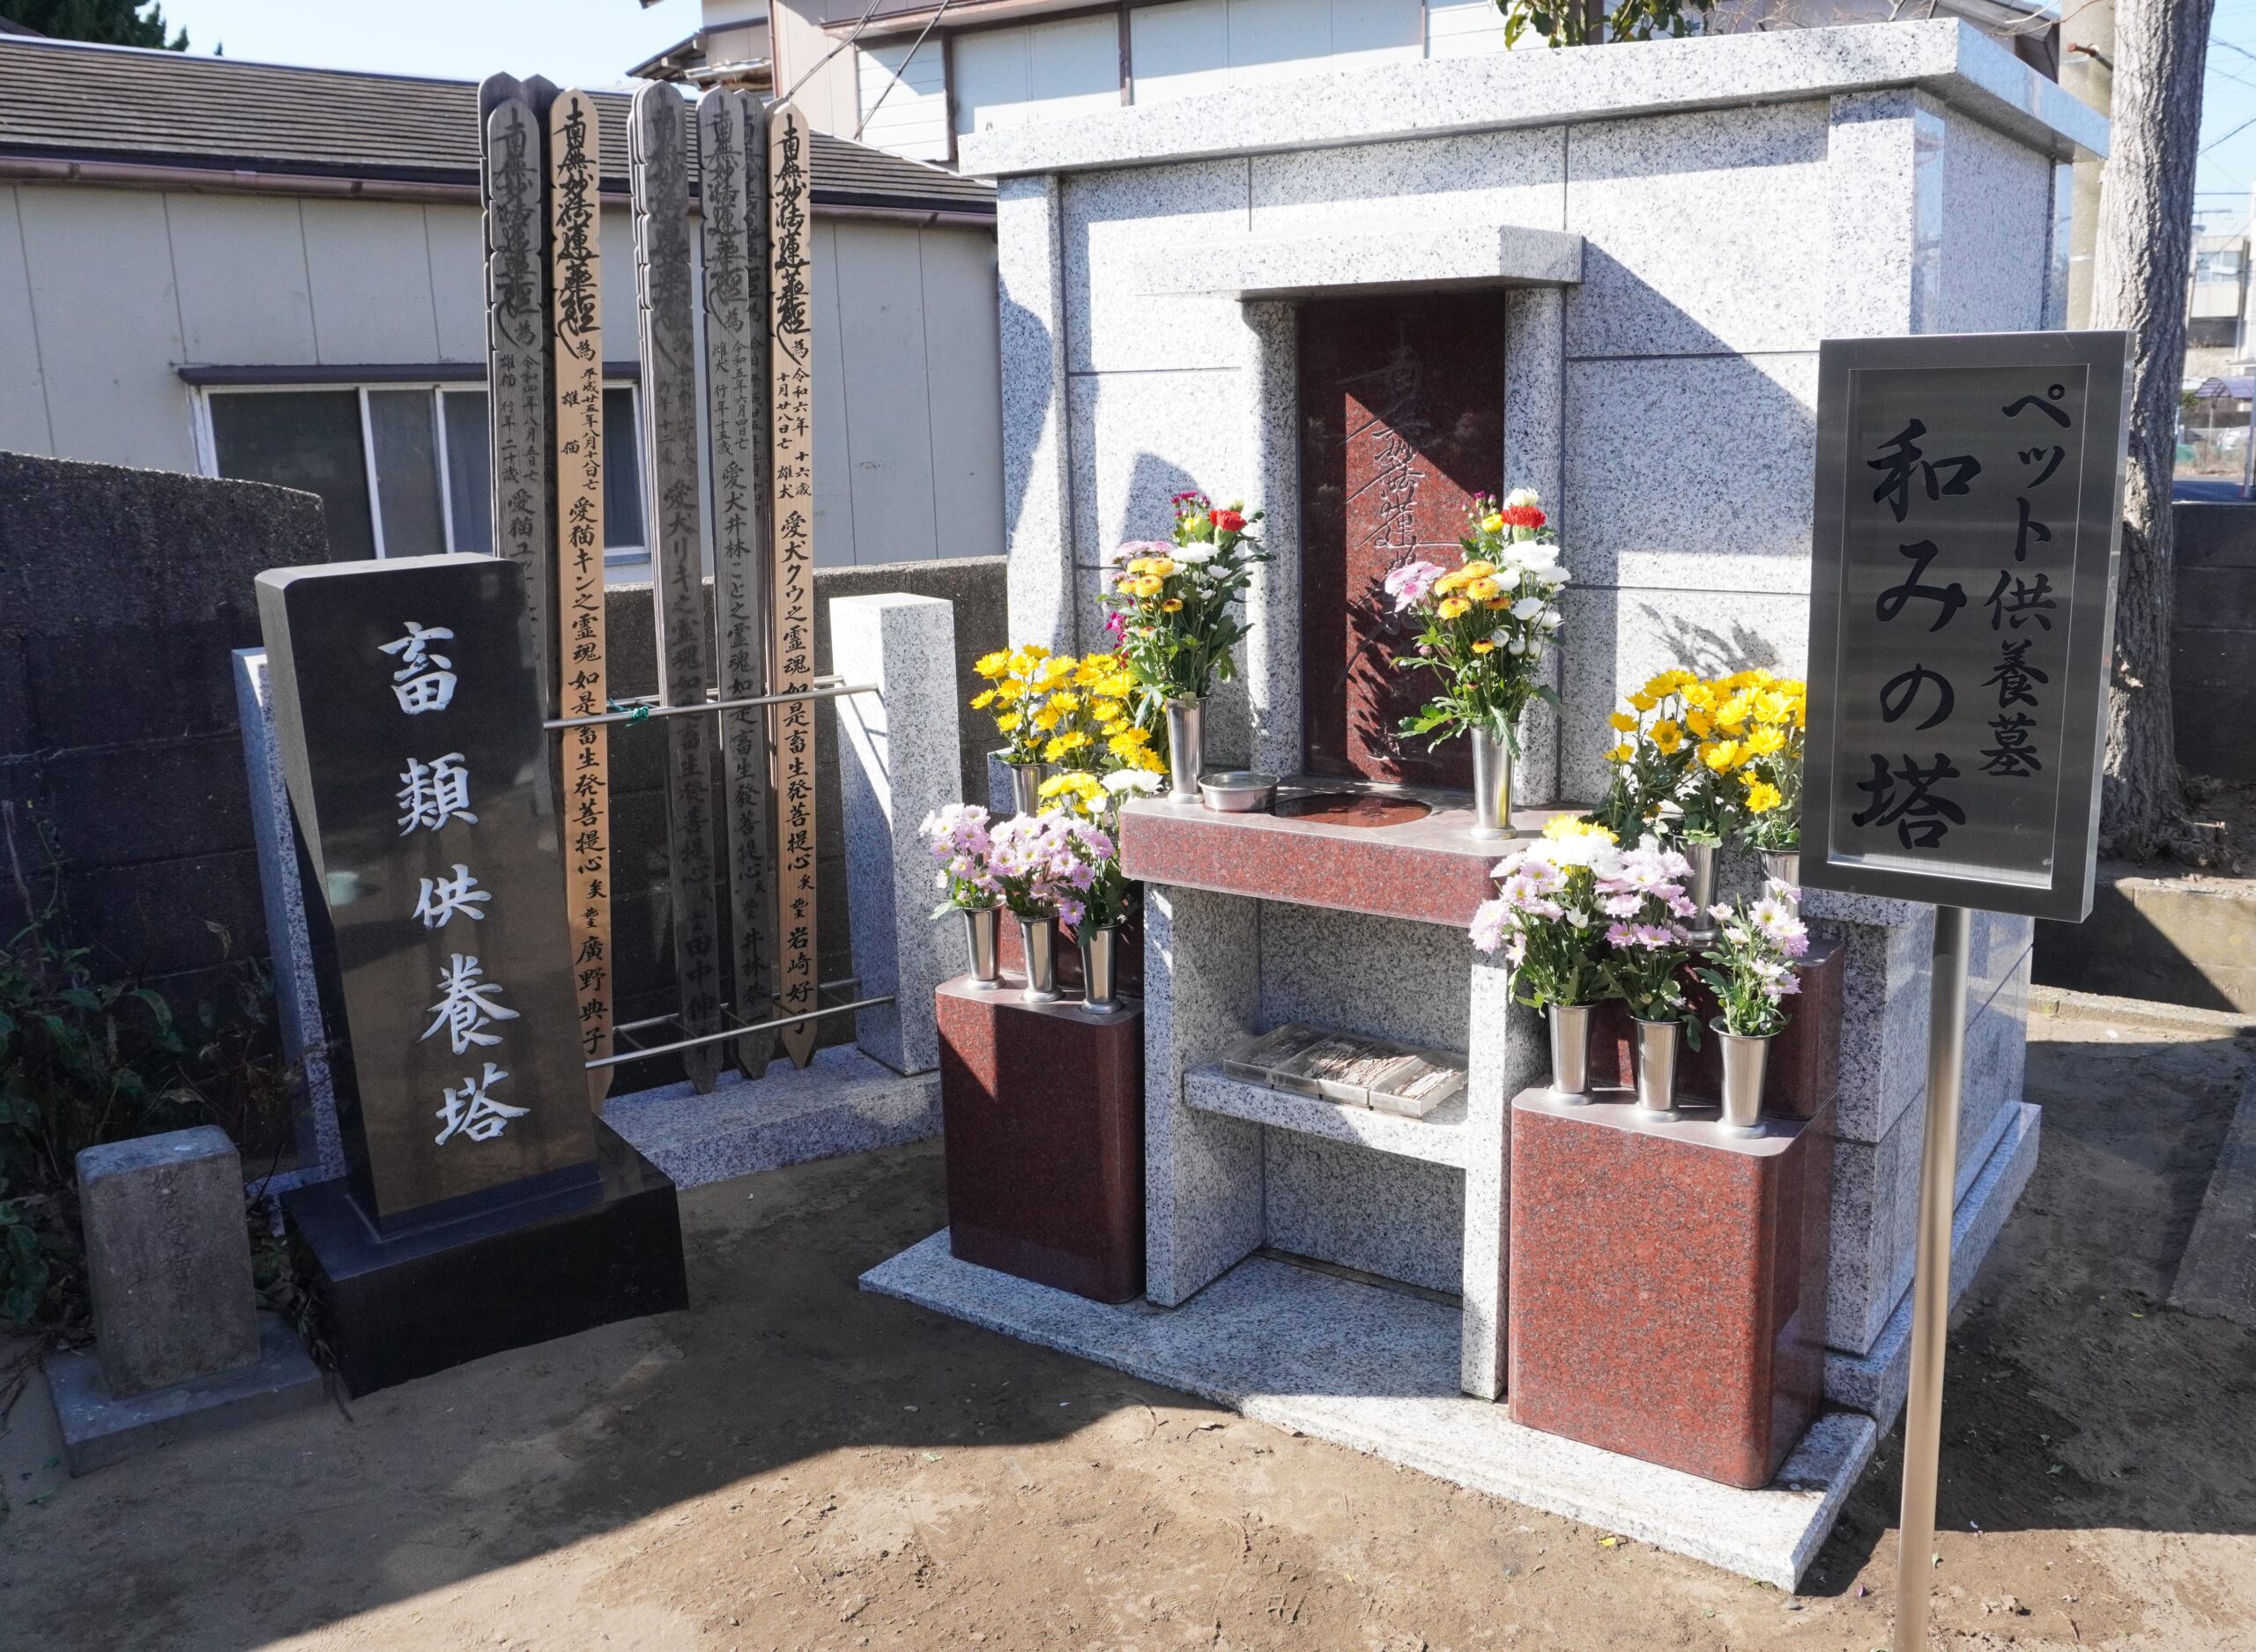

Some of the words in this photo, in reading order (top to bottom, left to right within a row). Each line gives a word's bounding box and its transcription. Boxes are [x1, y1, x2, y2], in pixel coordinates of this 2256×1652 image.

[1852, 418, 1982, 850] 和みの塔
[1978, 383, 2072, 778] ペット供養墓
[377, 621, 531, 1145] 畜類供養塔
